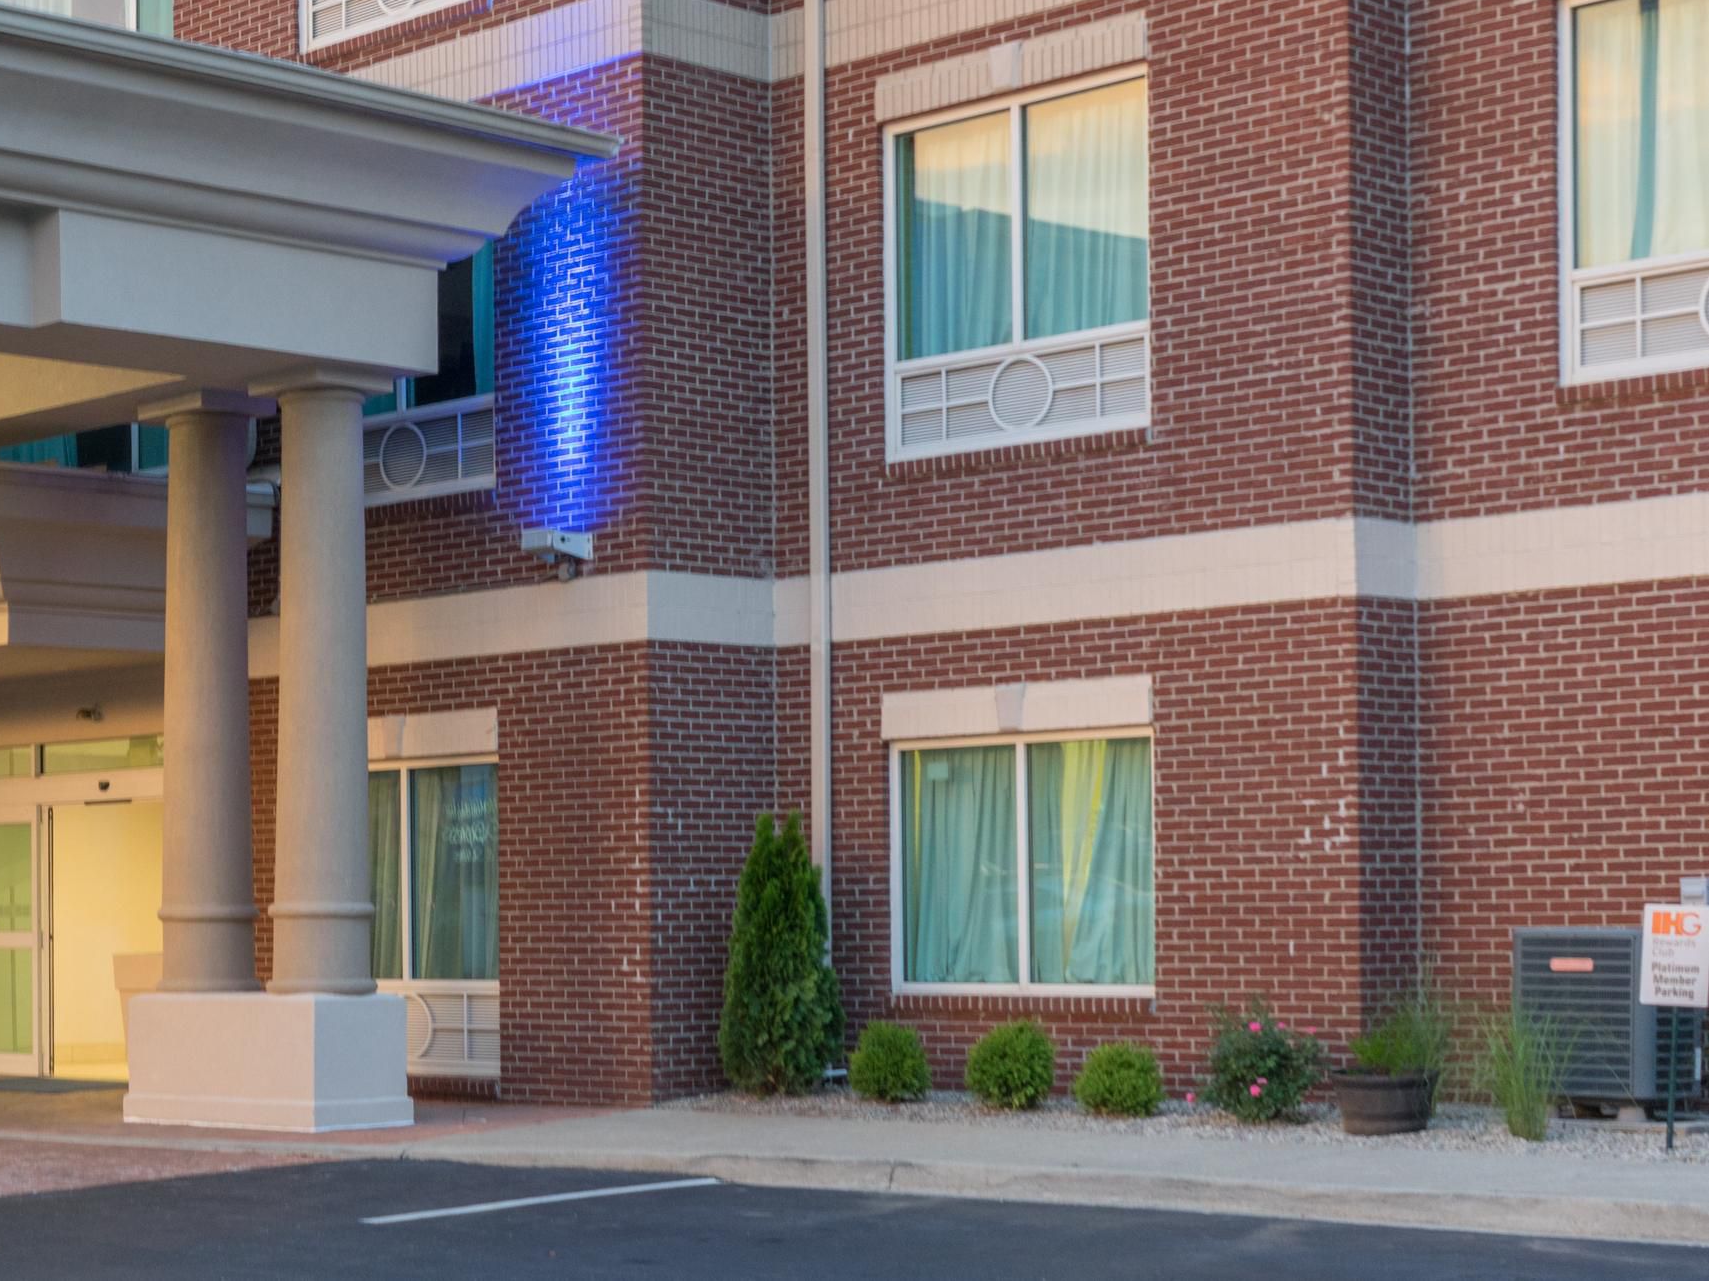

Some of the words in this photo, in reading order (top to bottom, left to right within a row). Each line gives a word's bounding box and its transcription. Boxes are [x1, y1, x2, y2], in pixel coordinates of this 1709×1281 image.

[1652, 911, 1701, 936] IHG
[1651, 962, 1700, 974] Platinum
[1653, 974, 1696, 986] Member
[1654, 986, 1695, 1000] Parking
